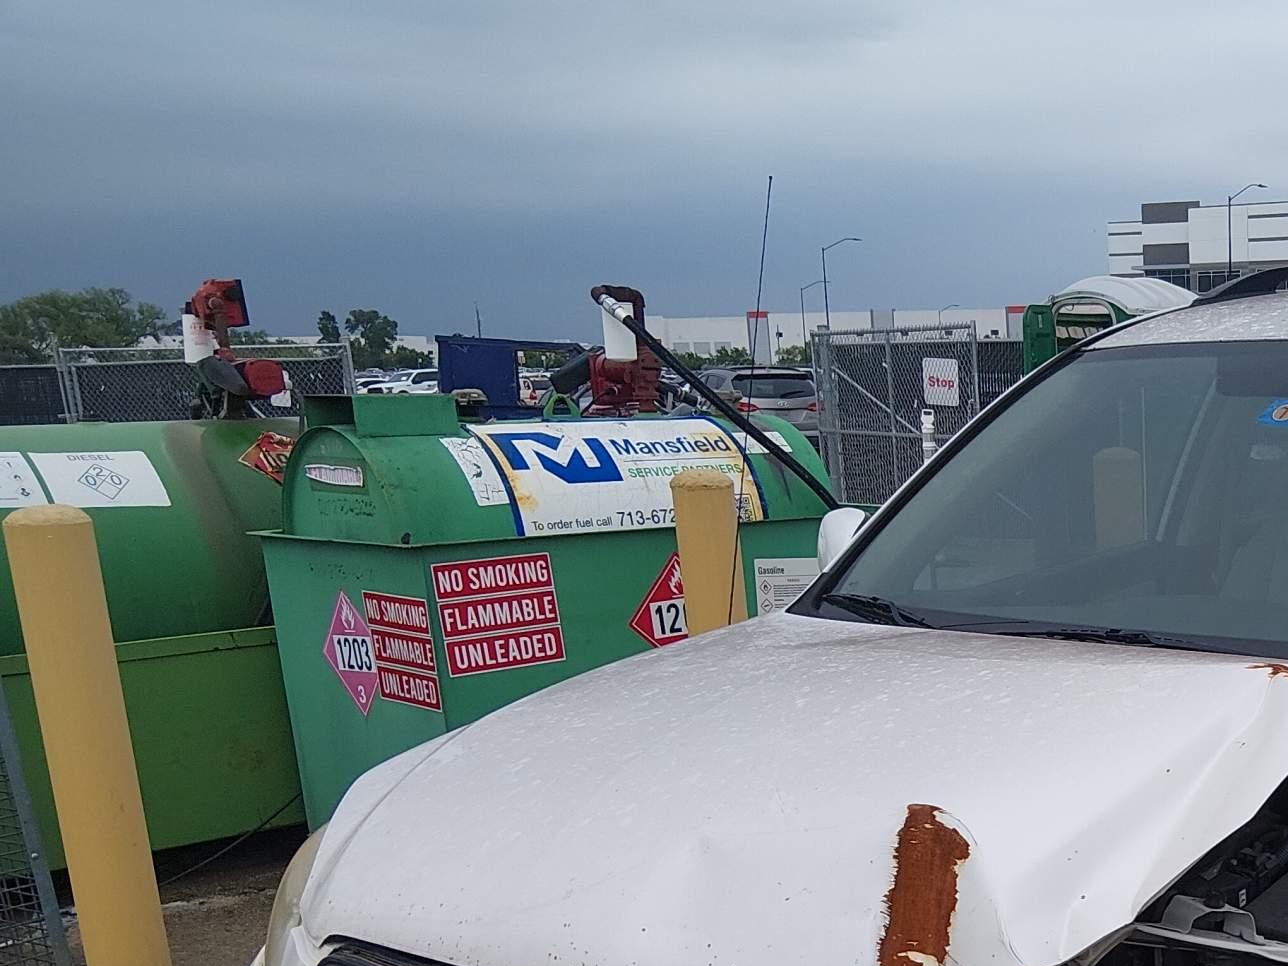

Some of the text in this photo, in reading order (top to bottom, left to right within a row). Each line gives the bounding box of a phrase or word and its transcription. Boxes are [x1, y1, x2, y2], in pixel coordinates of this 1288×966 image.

[928, 376, 954, 390] Stop
[608, 436, 731, 455] Mansfield
[93, 467, 106, 476] 2
[628, 465, 679, 478] SERVICE
[532, 521, 545, 531] To
[547, 519, 574, 530] order
[575, 517, 594, 529] fuel
[597, 516, 612, 527] call
[437, 560, 548, 593] NO SMOKING
[758, 566, 785, 575] Gasoline
[365, 599, 427, 629] NO SMOKING
[444, 596, 556, 632] FLAMMABLE
[655, 603, 688, 635] 12
[336, 637, 373, 671] 1203
[373, 634, 434, 667] FLAMMABLE
[454, 633, 557, 670] UNLEADED
[357, 686, 367, 704] 3
[382, 671, 437, 704] UNLEADED
